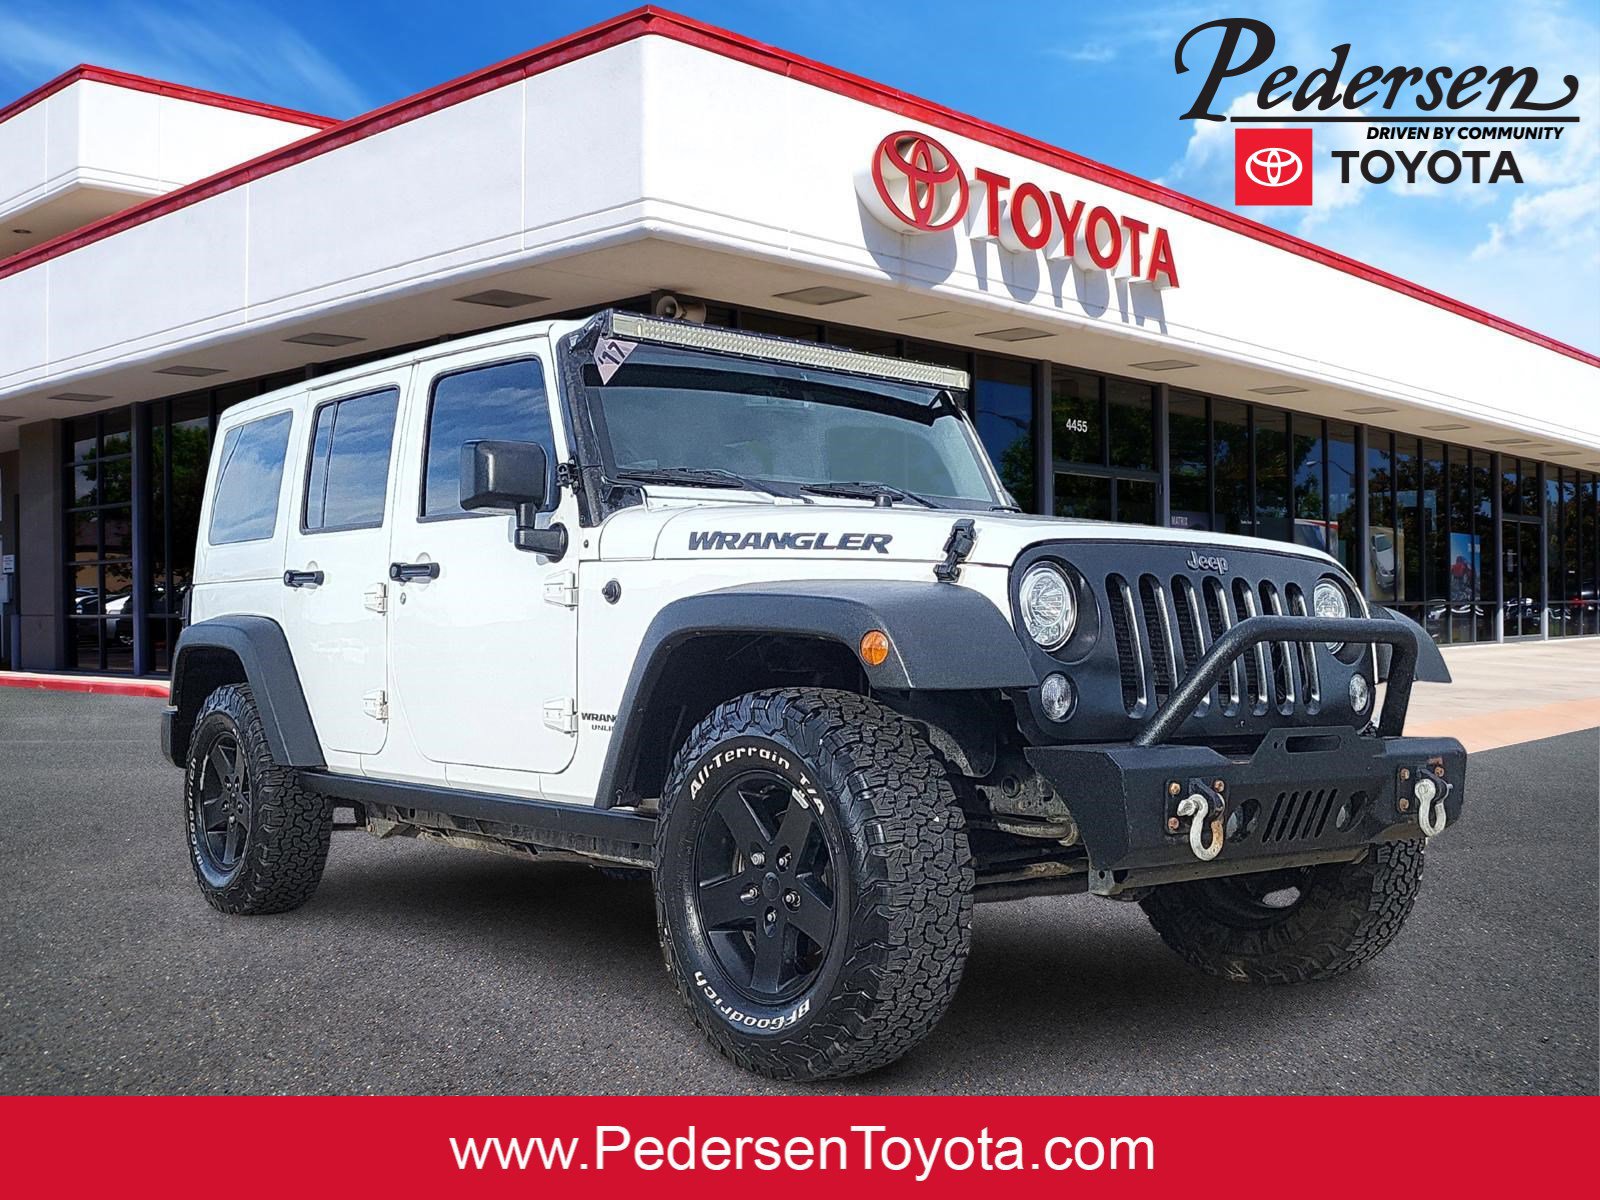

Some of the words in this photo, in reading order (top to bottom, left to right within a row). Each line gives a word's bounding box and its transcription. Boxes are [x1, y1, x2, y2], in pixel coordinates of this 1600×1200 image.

[974, 167, 1180, 288] TOYOTA
[1065, 418, 1088, 433] 4455
[1171, 515, 1189, 526] MATRIX
[688, 530, 893, 554] WRANGLER
[1186, 549, 1229, 575] Jeep
[581, 712, 618, 723] WRAN
[591, 724, 615, 732] UNLI
[689, 747, 791, 801] All-Terrain
[799, 772, 826, 816] T/A
[693, 970, 811, 1031] BFGoodrich
